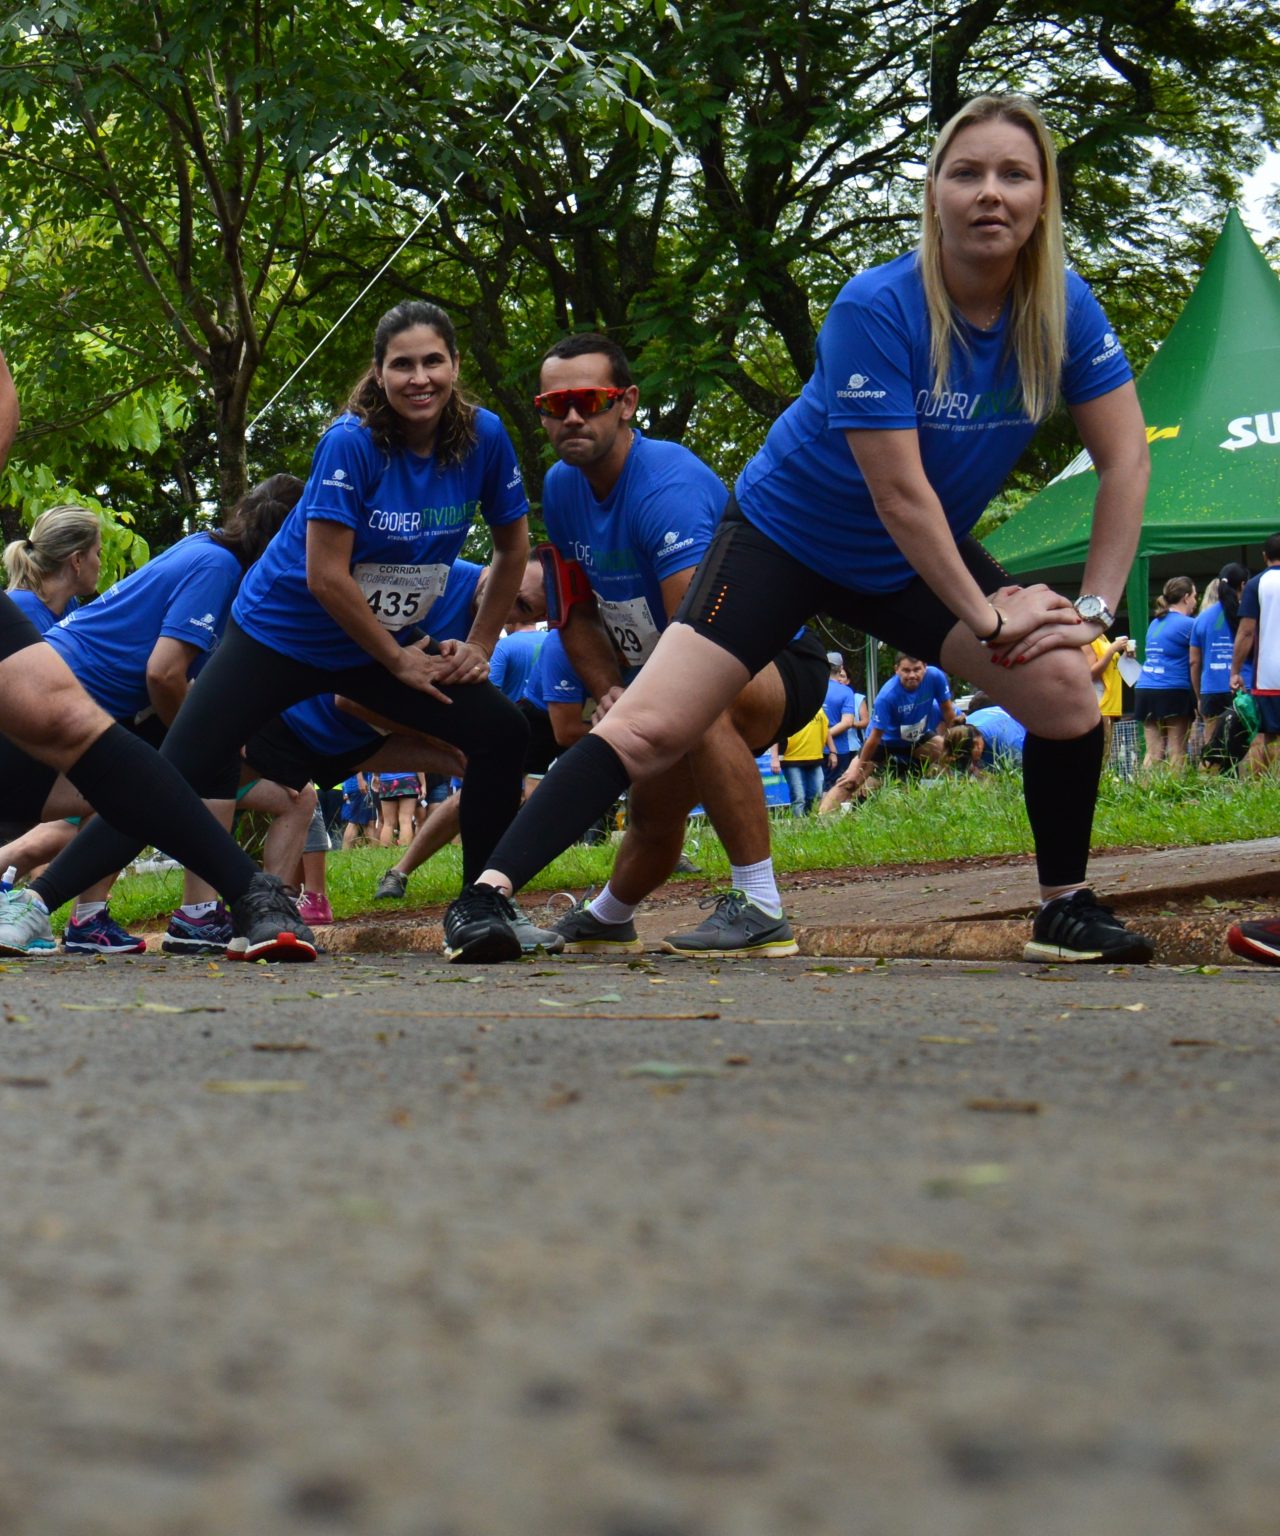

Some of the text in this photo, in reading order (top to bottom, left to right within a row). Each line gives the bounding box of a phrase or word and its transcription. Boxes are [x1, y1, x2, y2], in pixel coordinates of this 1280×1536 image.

[836, 390, 886, 399] SESCOOP/SP
[379, 565, 421, 575] CORRIDA
[367, 589, 421, 618] 435
